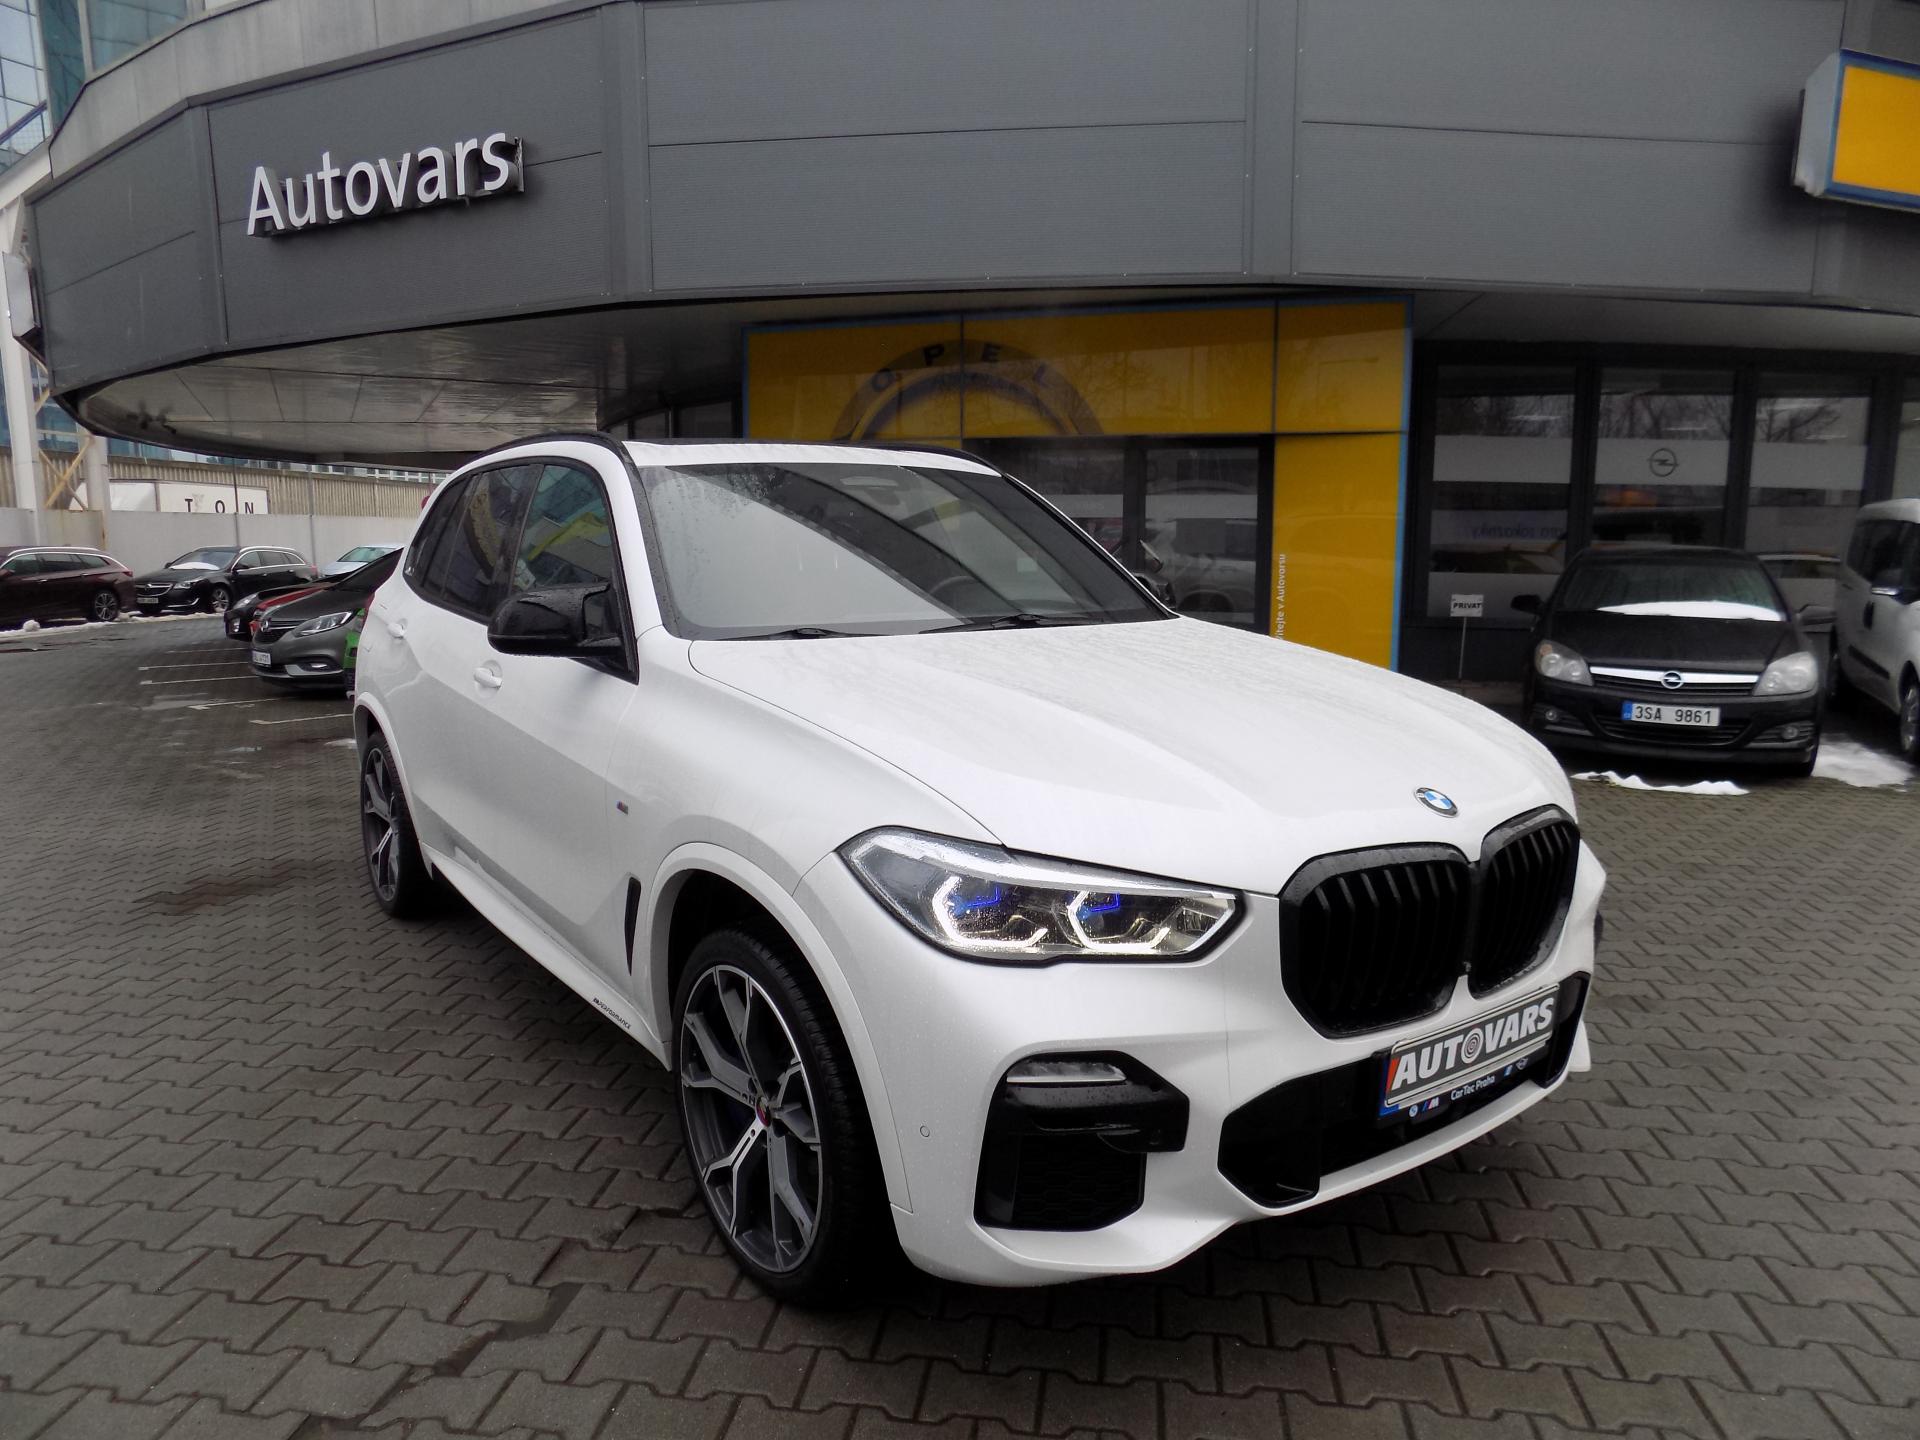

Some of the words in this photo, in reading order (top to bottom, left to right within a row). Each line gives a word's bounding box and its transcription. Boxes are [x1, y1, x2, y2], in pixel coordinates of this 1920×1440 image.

[247, 132, 510, 236] Autovars
[1635, 705, 1662, 720] 3SA
[1675, 709, 1711, 723] 9861
[1391, 997, 1554, 1091] AUTOVARS
[1476, 1075, 1495, 1092] Praha
